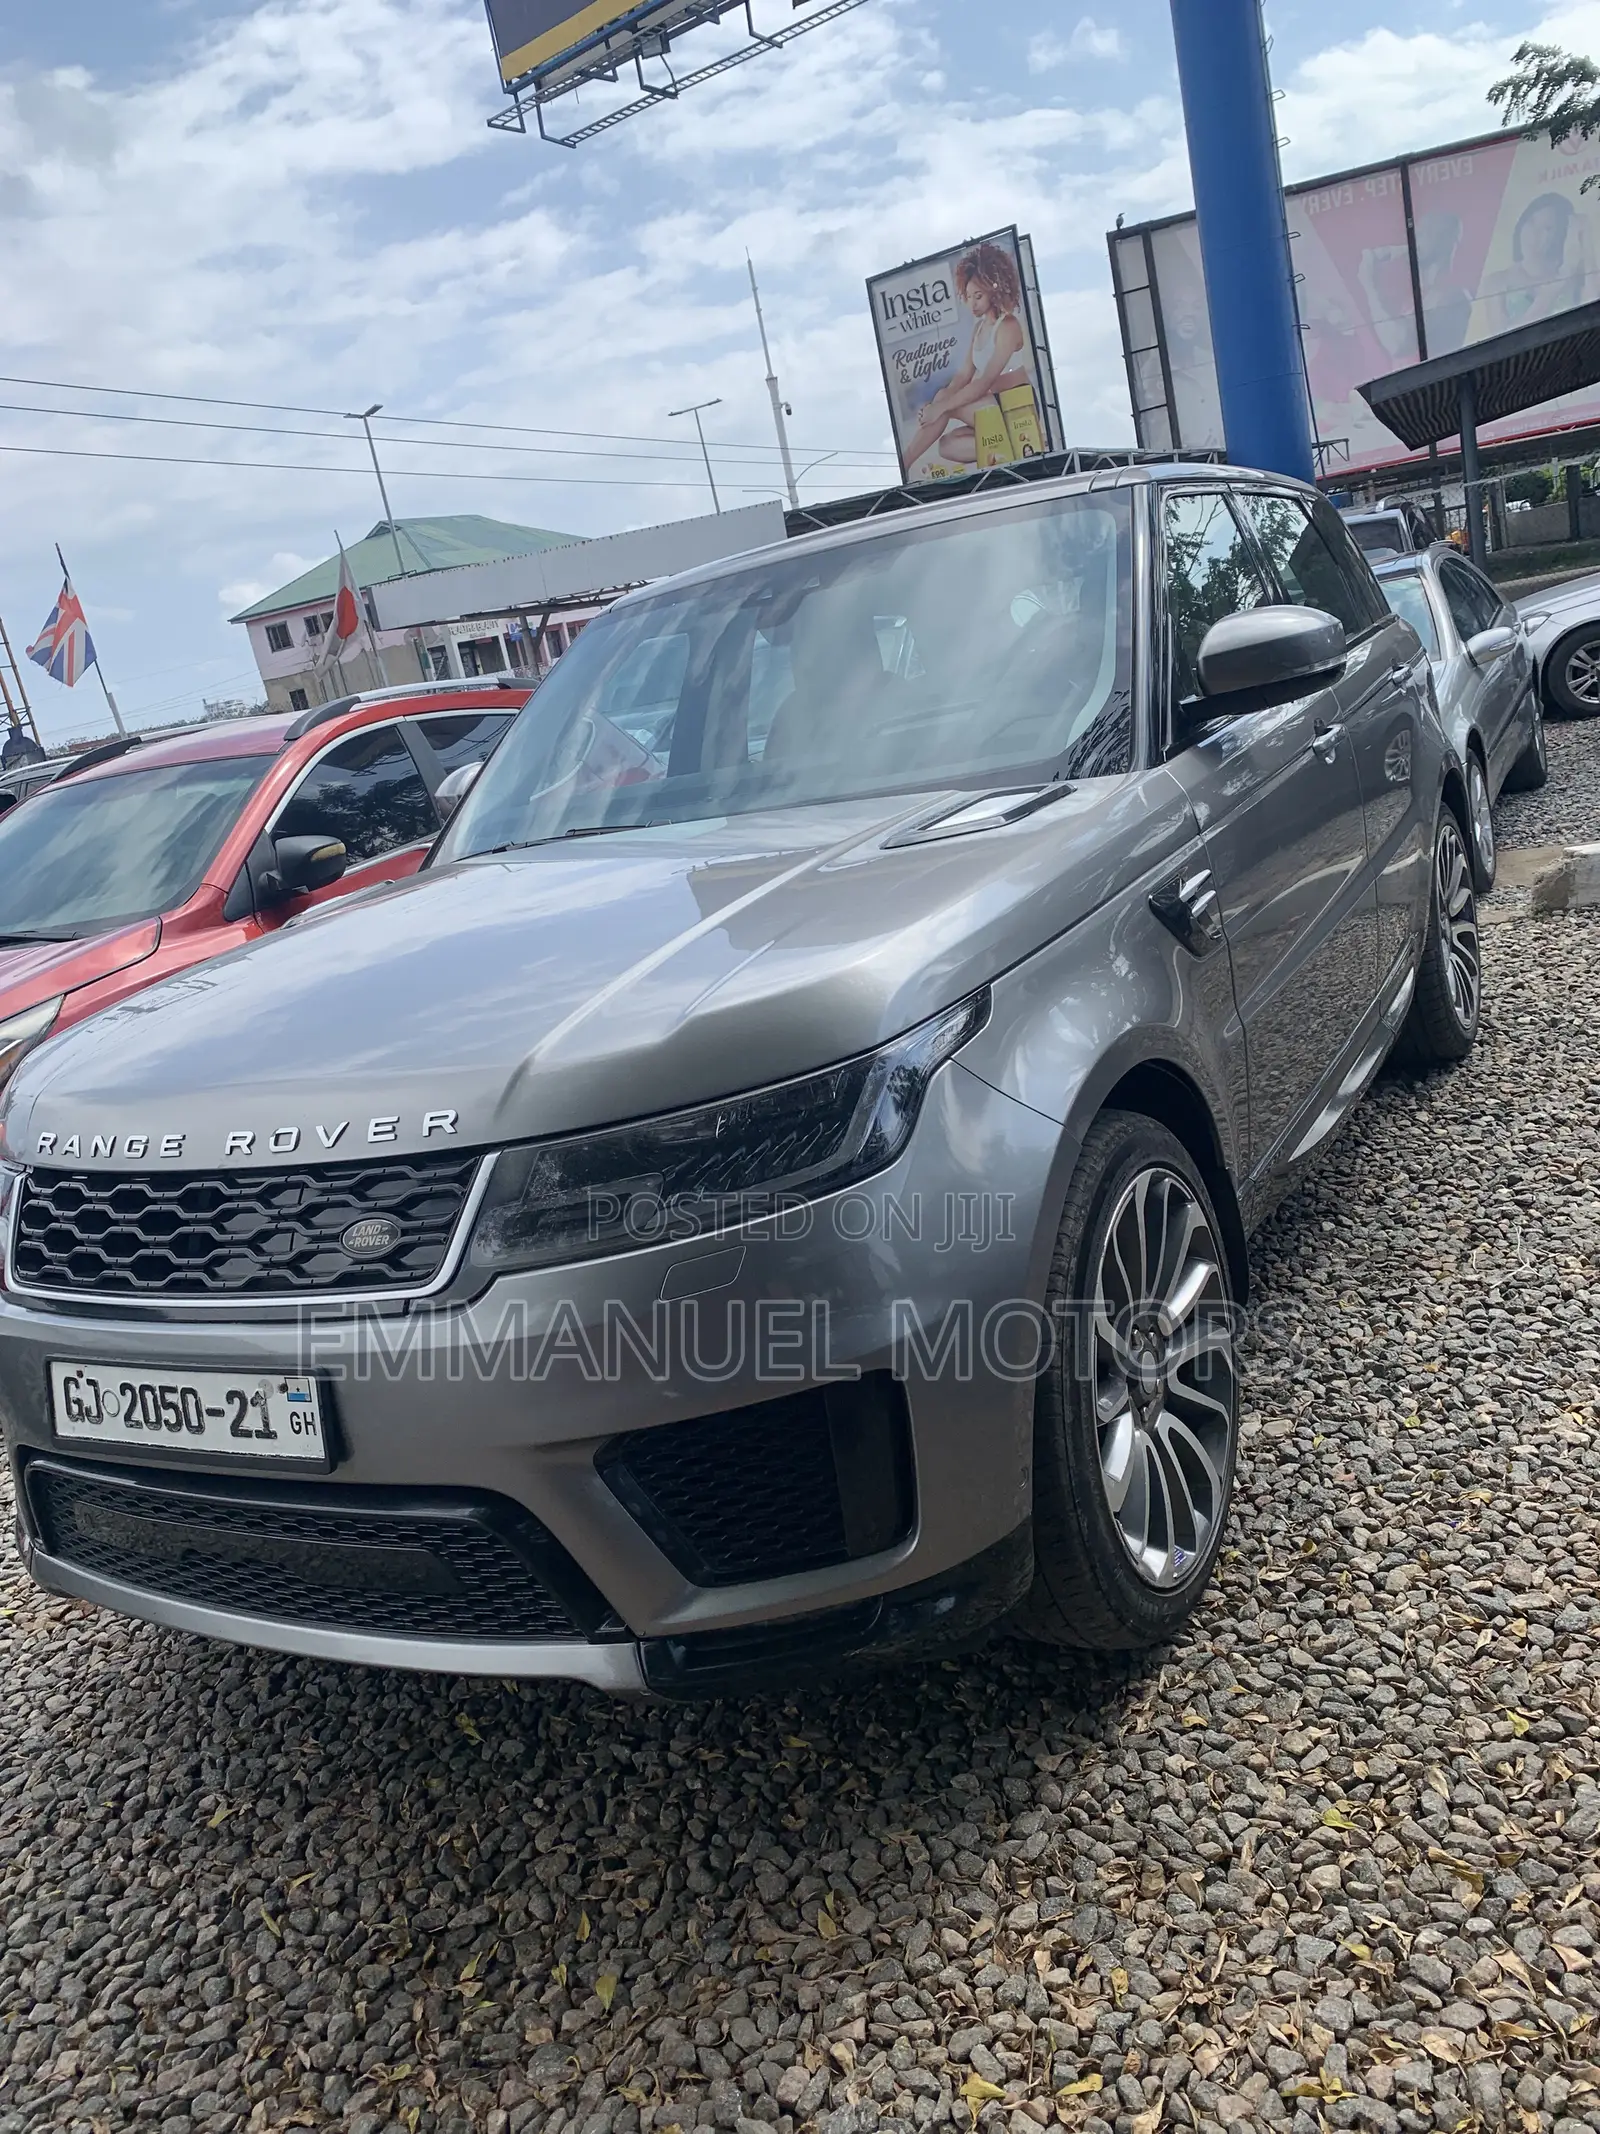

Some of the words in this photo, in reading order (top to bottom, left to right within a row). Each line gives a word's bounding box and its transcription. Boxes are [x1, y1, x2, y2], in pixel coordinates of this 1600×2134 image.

[880, 278, 951, 321] Insta
[899, 308, 942, 333] white
[892, 335, 958, 370] Radiance
[900, 368, 912, 385] &
[912, 350, 951, 383] light
[981, 432, 1004, 447] Insta
[1013, 418, 1033, 430] Insta
[36, 1131, 187, 1160] RANGE
[225, 1108, 459, 1156] ROVER
[353, 1234, 390, 1247] ROVER
[63, 1375, 104, 1425] GJ
[119, 1381, 278, 1440] 2050-21
[289, 1410, 318, 1437] GH
